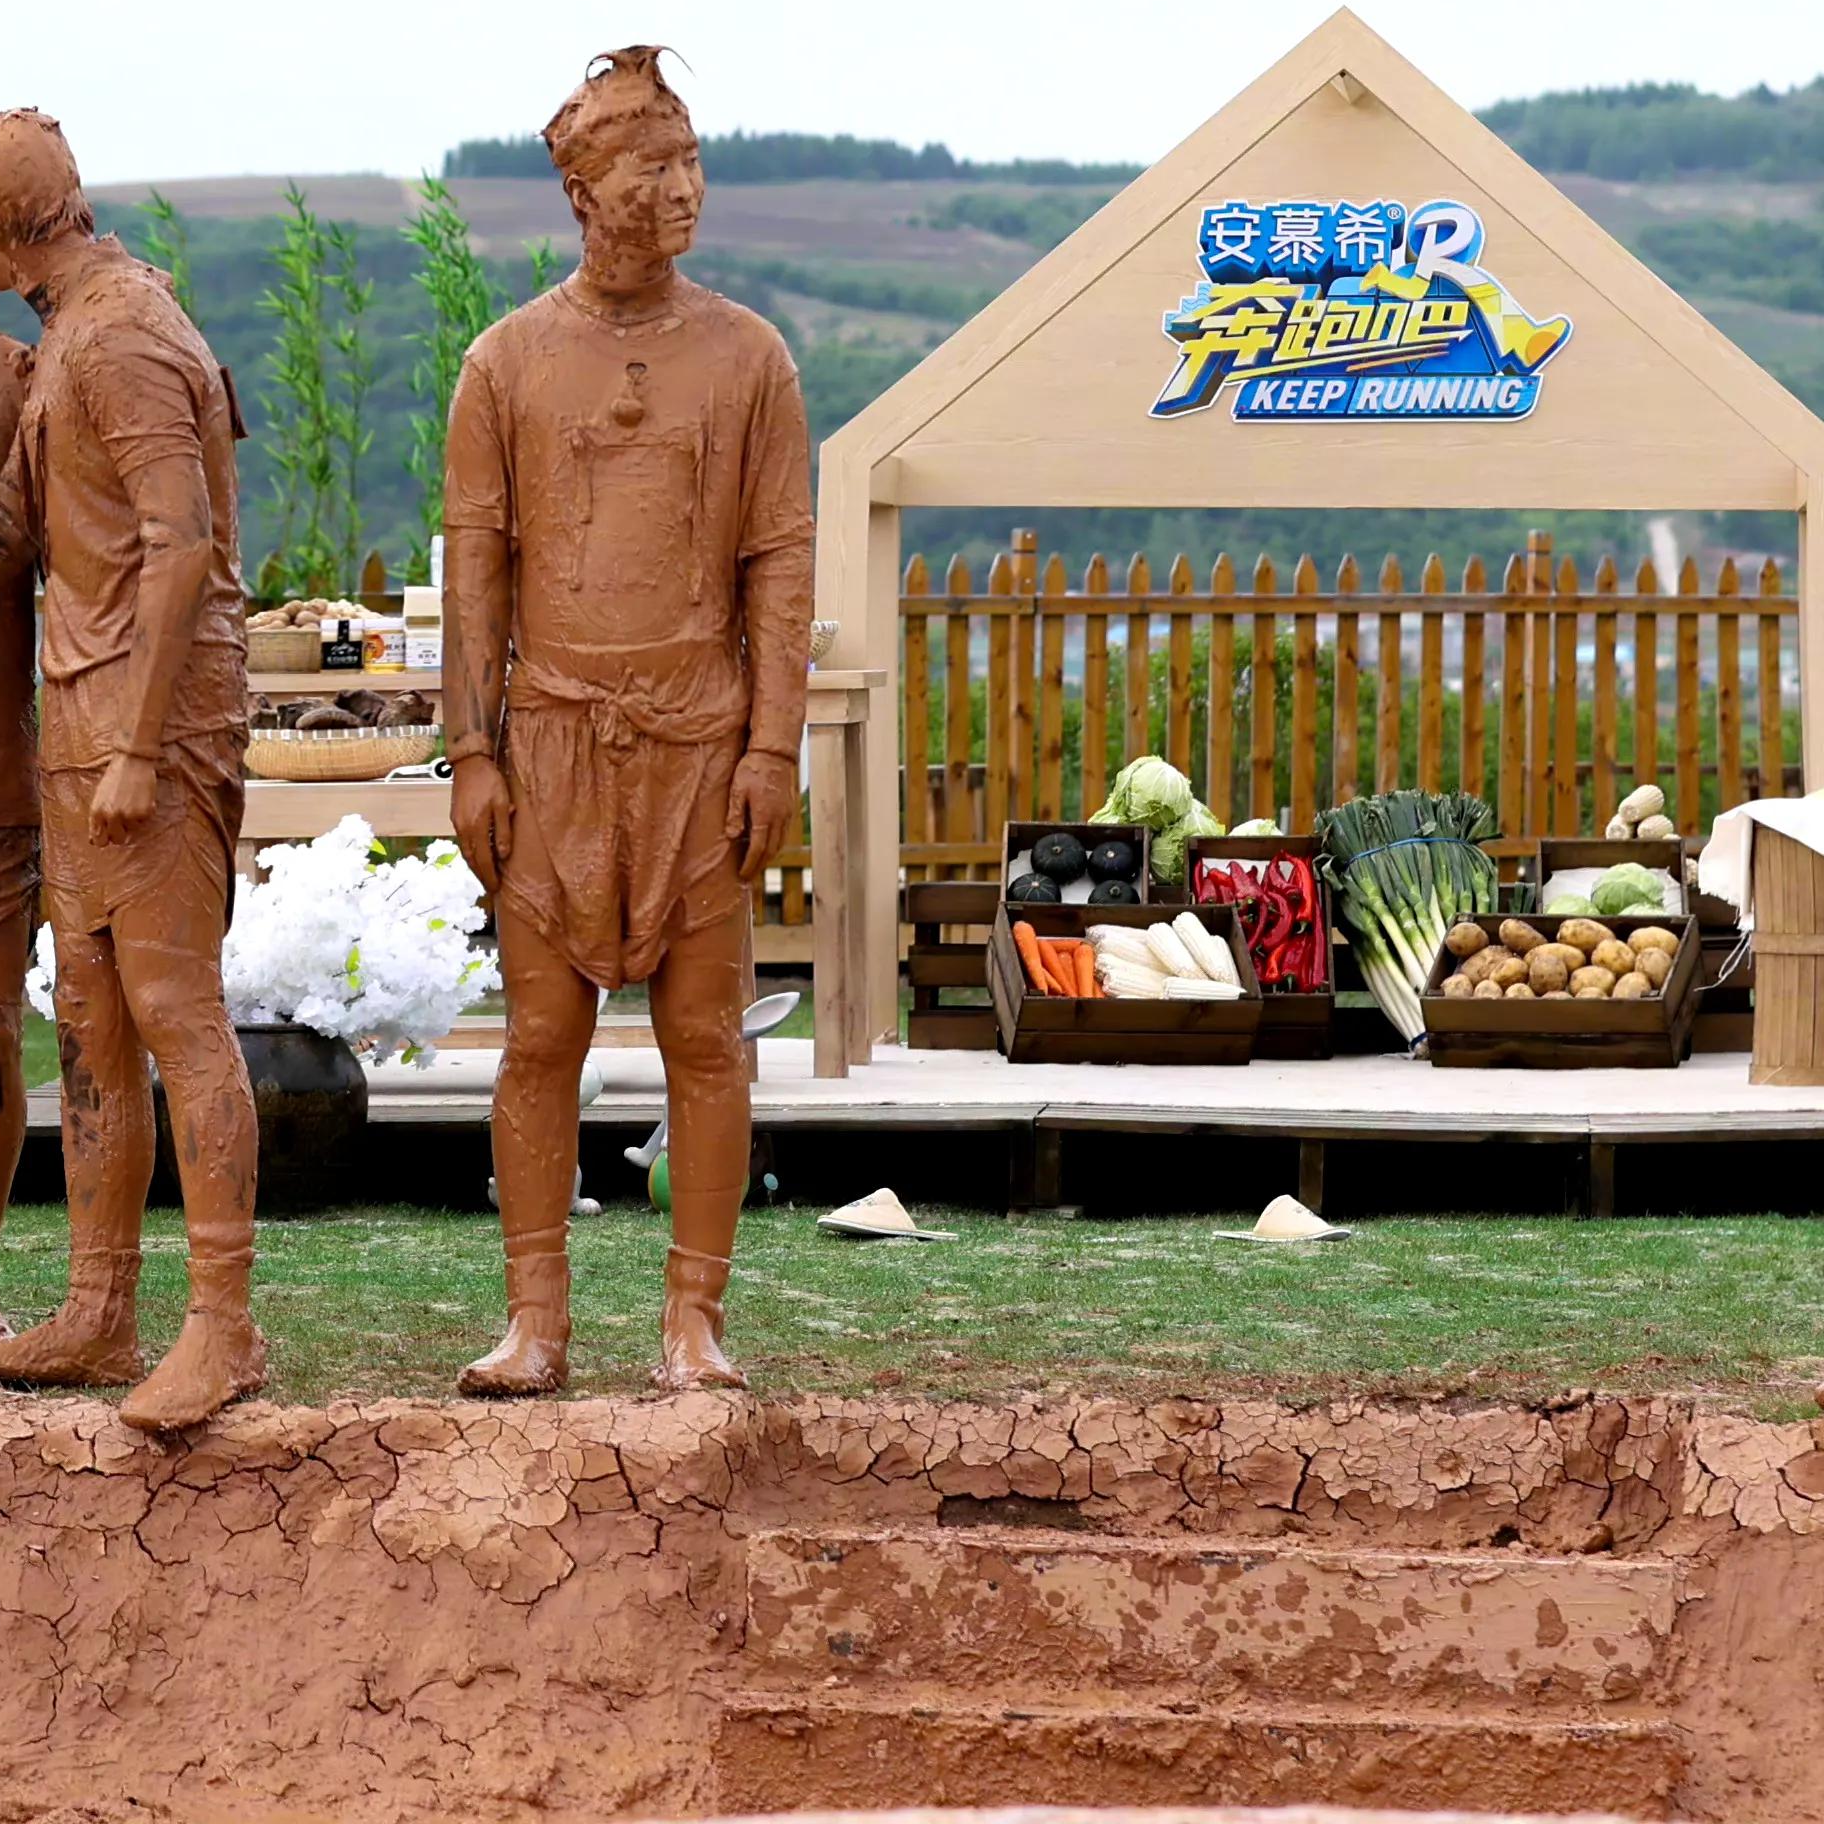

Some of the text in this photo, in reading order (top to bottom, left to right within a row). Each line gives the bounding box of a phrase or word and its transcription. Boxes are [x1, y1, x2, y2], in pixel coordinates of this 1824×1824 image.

[1162, 280, 1469, 404] 奔跑吧
[1250, 378, 1525, 412] KEEP RUNNING
